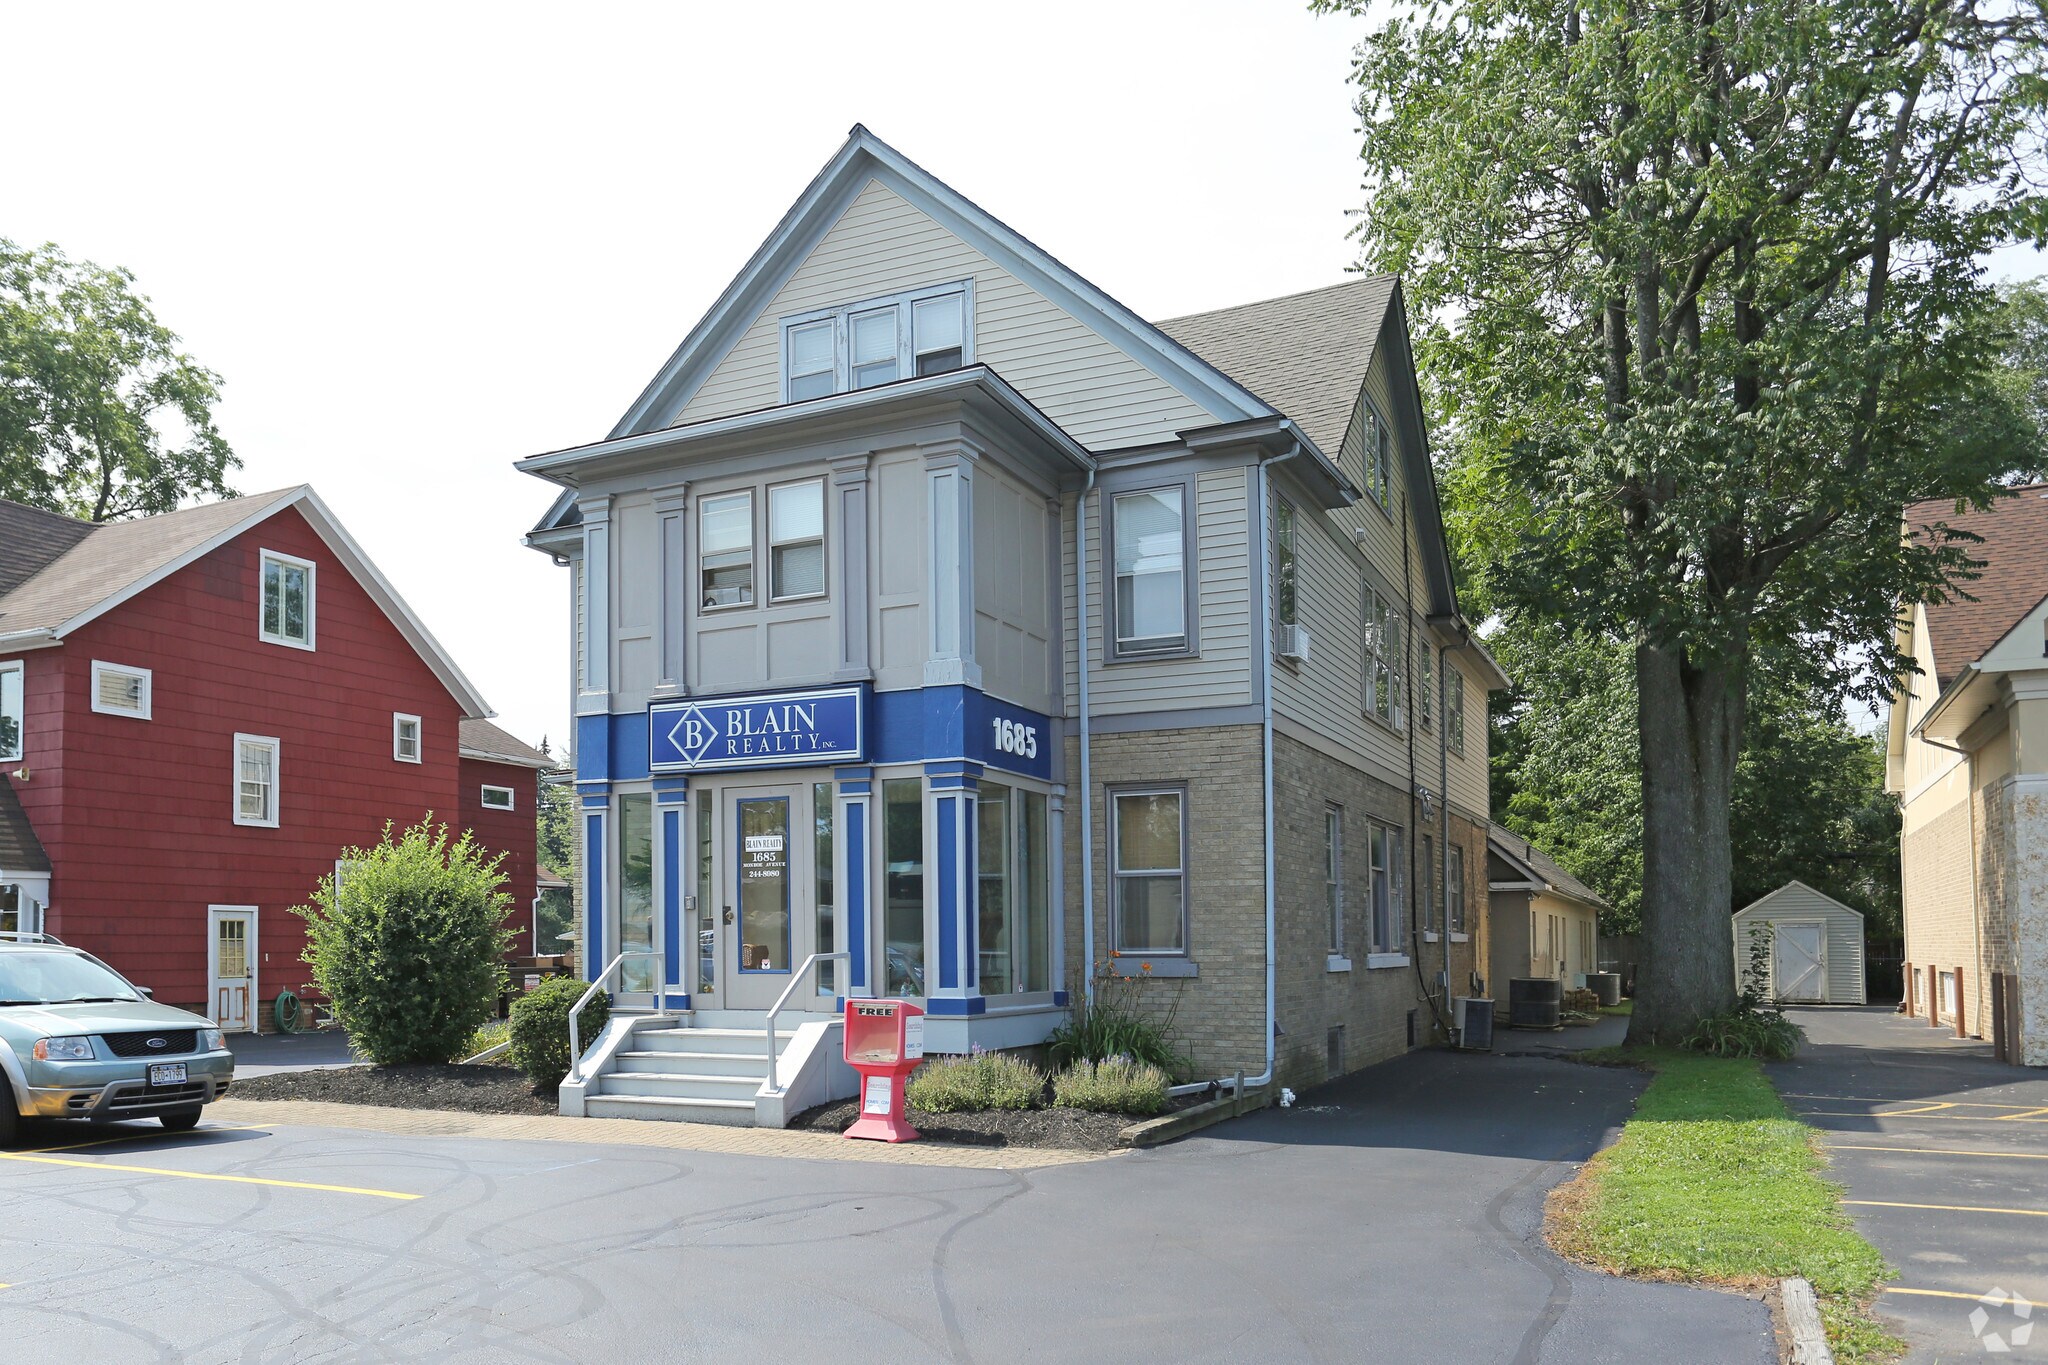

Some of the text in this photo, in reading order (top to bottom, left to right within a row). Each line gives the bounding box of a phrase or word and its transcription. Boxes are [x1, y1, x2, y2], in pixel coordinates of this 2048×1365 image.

[726, 703, 816, 737] BLAIN
[684, 720, 703, 750] B
[993, 717, 1037, 759] 1685
[746, 838, 782, 849] BLAIN REALTY
[752, 852, 776, 862] 1685
[858, 1007, 892, 1016] FREE
